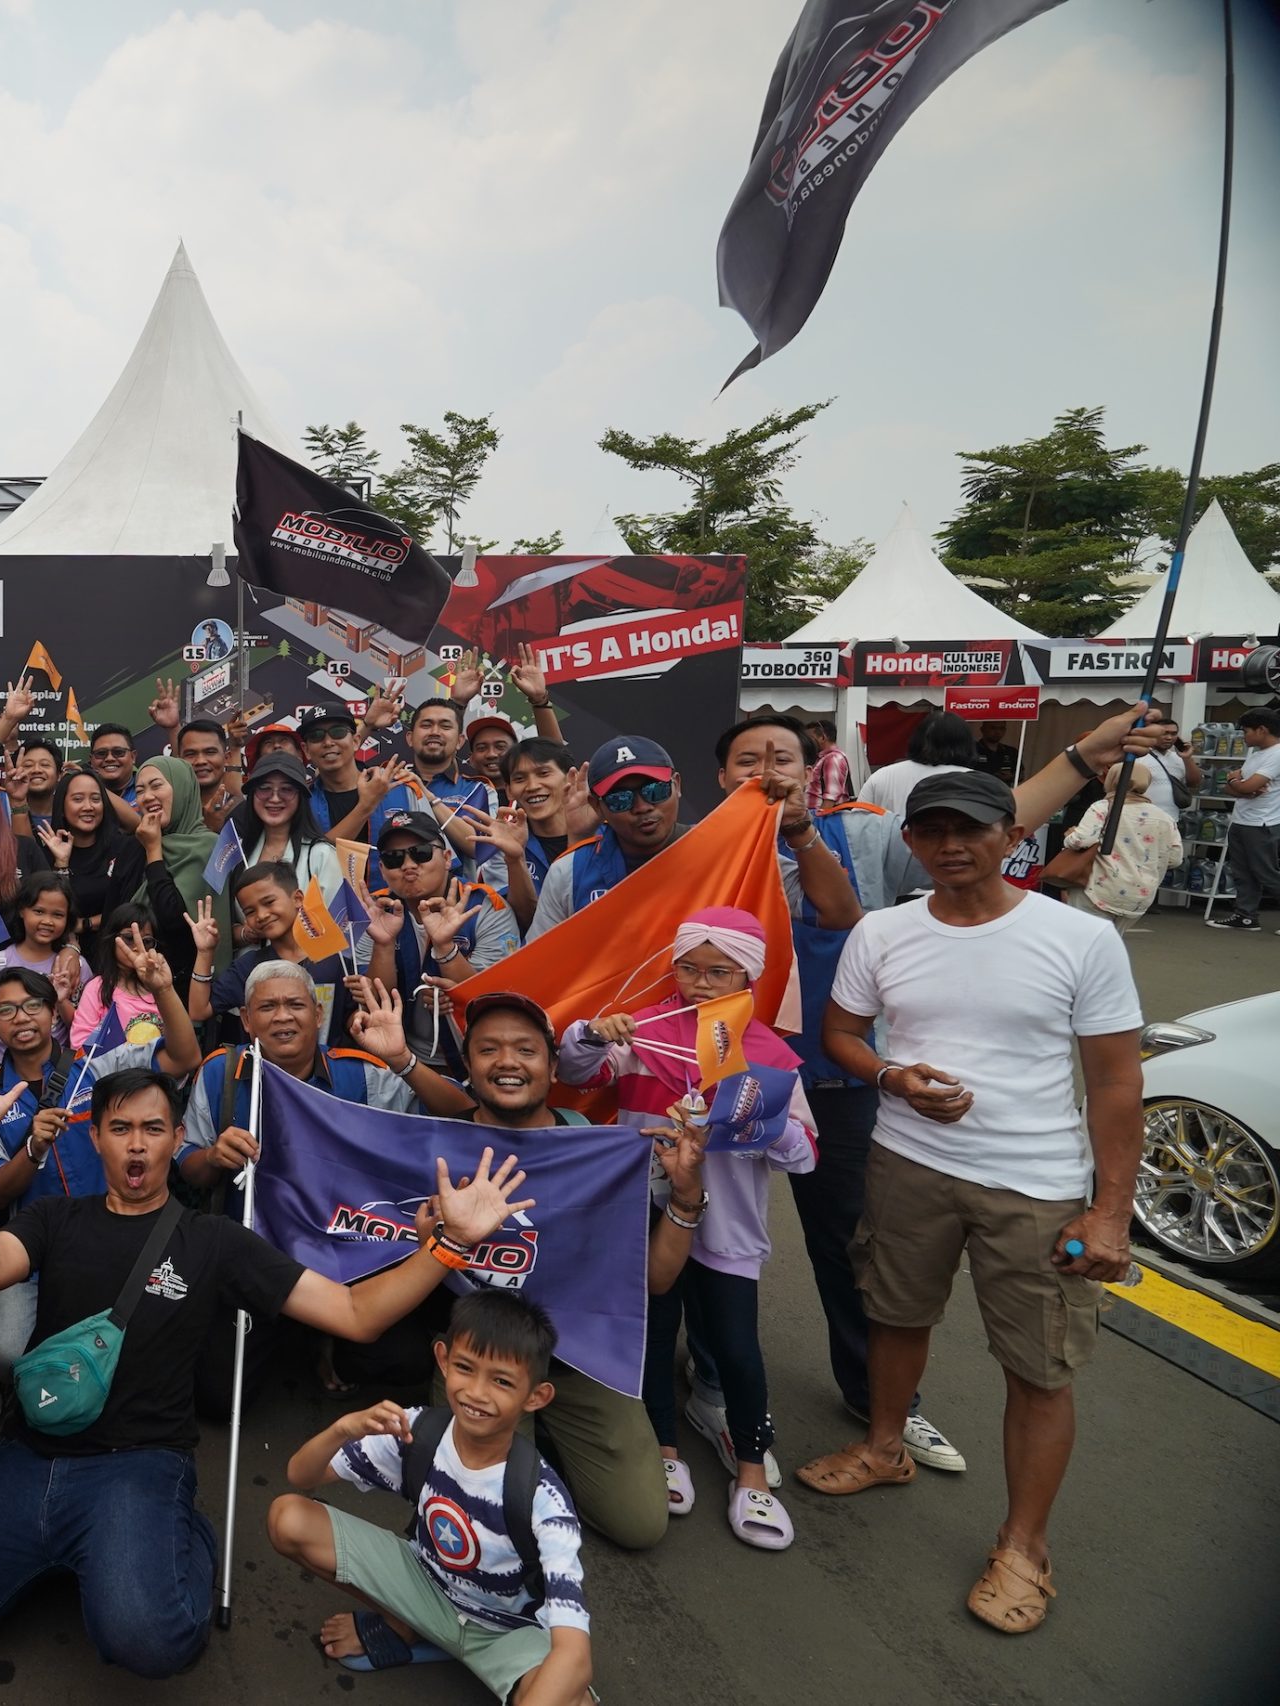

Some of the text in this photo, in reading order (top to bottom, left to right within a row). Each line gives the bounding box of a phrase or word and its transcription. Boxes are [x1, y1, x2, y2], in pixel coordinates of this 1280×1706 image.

[280, 513, 404, 562] MOBILIO
[275, 530, 394, 572] INDONESIA
[270, 540, 392, 582] www.mobilioindonesia.club
[539, 614, 738, 673] IT'S A Honda!
[186, 648, 205, 659] 15
[442, 648, 462, 660] 18
[803, 651, 832, 662] 360
[943, 651, 1000, 663] CULTURE
[329, 663, 350, 675] 16
[867, 655, 942, 673] Honda
[943, 664, 1000, 673] INDONESIA
[482, 684, 503, 696] 19
[314, 705, 327, 718] LA
[348, 702, 366, 715] 13
[18, 722, 56, 731] ontest
[616, 746, 637, 763] A
